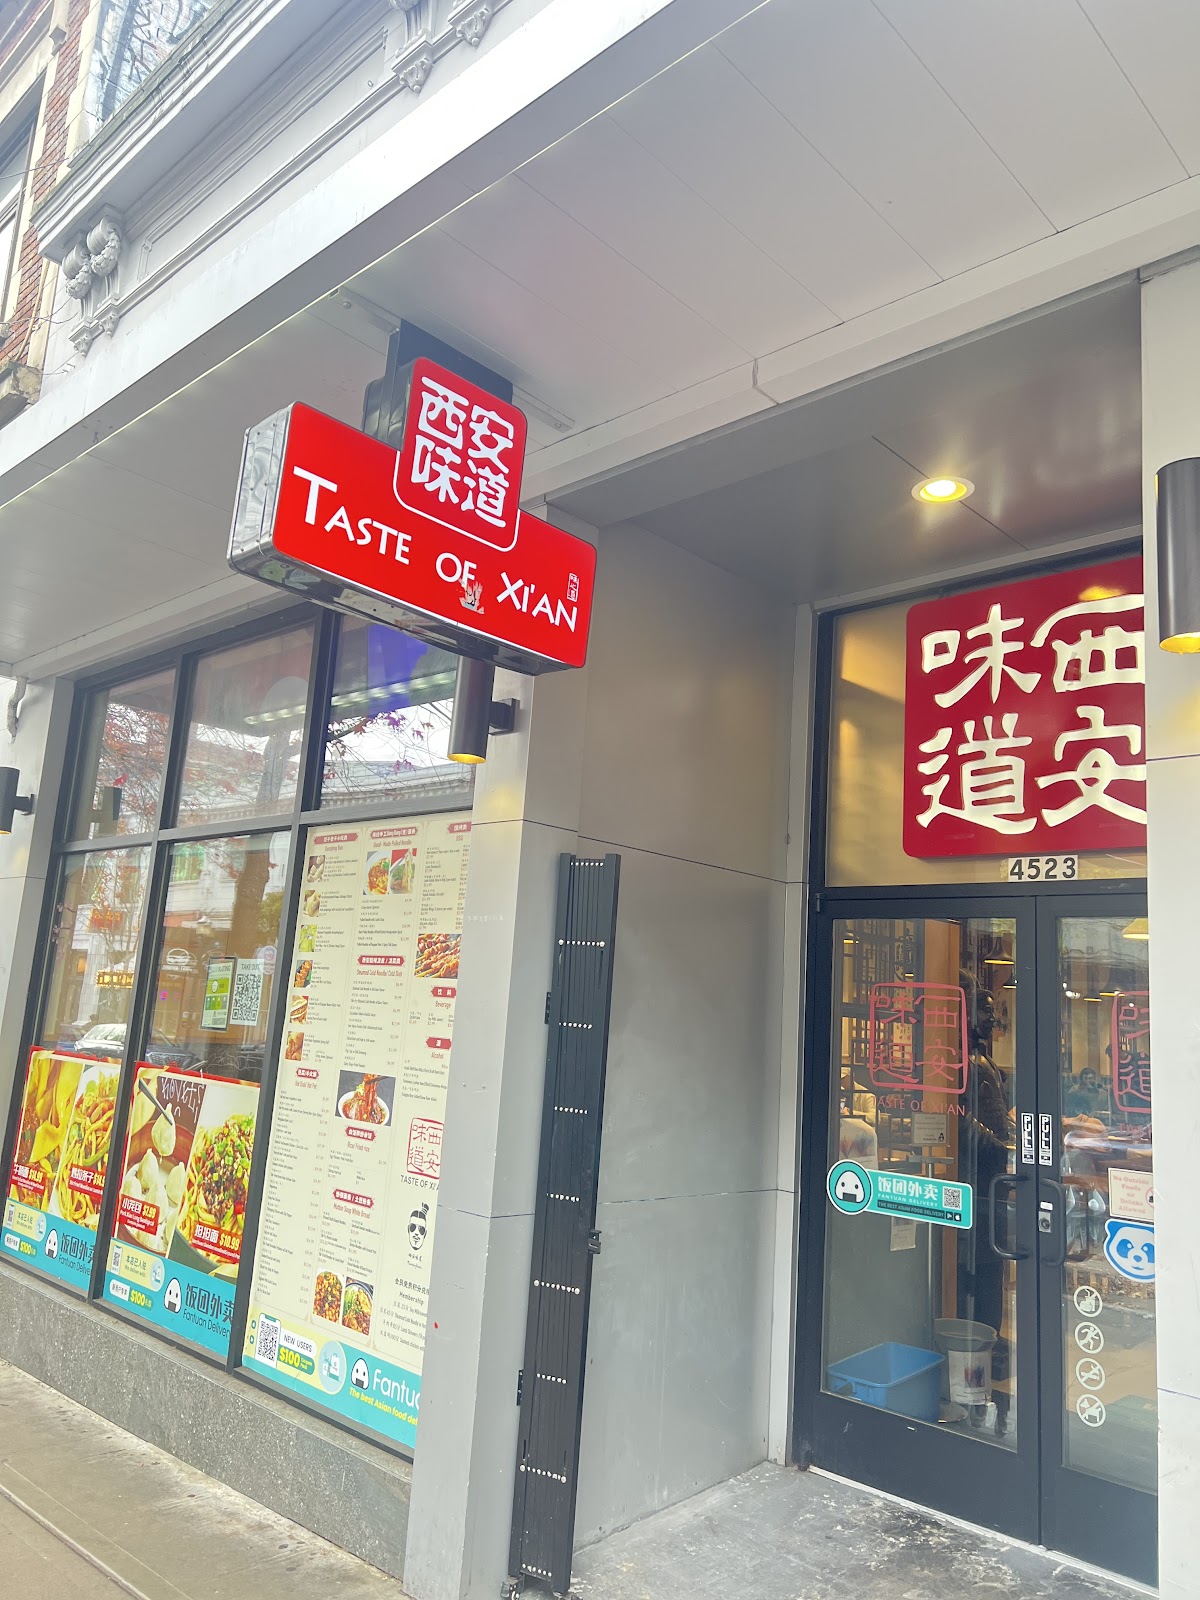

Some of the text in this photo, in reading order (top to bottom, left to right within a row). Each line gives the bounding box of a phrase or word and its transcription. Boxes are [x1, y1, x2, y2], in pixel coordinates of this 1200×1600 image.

[419, 376, 514, 473] 西安
[411, 435, 510, 528] 味道
[293, 465, 412, 565] TASTE
[435, 552, 477, 587] OF
[496, 571, 578, 633] XI'AN
[916, 602, 1042, 835] 味道
[1030, 593, 1147, 828] 西安
[1010, 857, 1077, 880] 4523
[1023, 1115, 1032, 1147] PULL
[1041, 1116, 1050, 1149] PULL
[400, 1174, 419, 1187] TASTE
[420, 1179, 428, 1188] OF
[878, 1176, 938, 1200] 饭团外卖
[219, 1230, 240, 1251] $10.99
[399, 1291, 424, 1306] Membership
[183, 1309, 207, 1330] Fantuan
[279, 1346, 301, 1368] $100
[283, 1334, 313, 1353] NEW USERS
[349, 1386, 360, 1399] The
[374, 1396, 392, 1414] Asian
[392, 1403, 407, 1421] food
